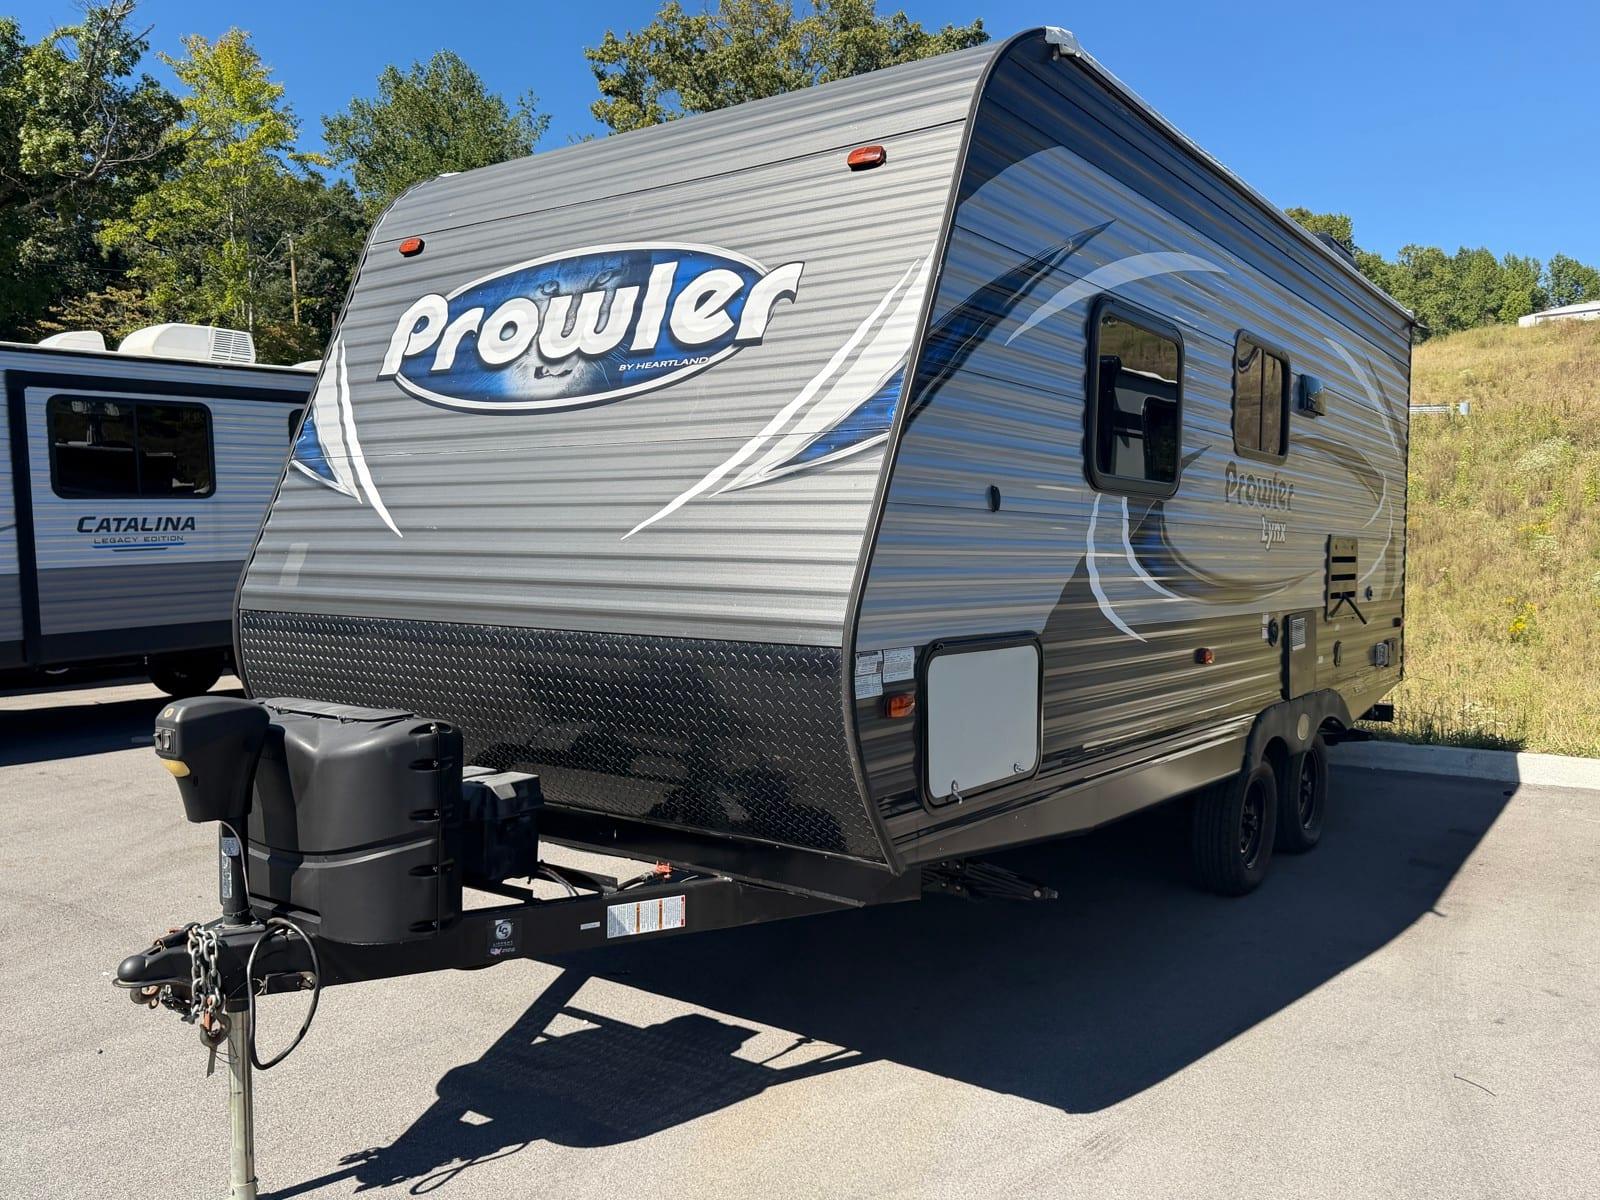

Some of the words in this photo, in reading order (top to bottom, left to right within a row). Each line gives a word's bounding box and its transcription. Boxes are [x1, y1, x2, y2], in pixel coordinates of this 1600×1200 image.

[376, 260, 805, 381] Prowler
[618, 363, 634, 371] BY
[635, 357, 709, 370] HEARTLAND
[1225, 460, 1295, 511] Prowler
[76, 516, 196, 533] CATALINA
[1260, 514, 1286, 551] Lynx
[93, 536, 139, 544] LEGACY
